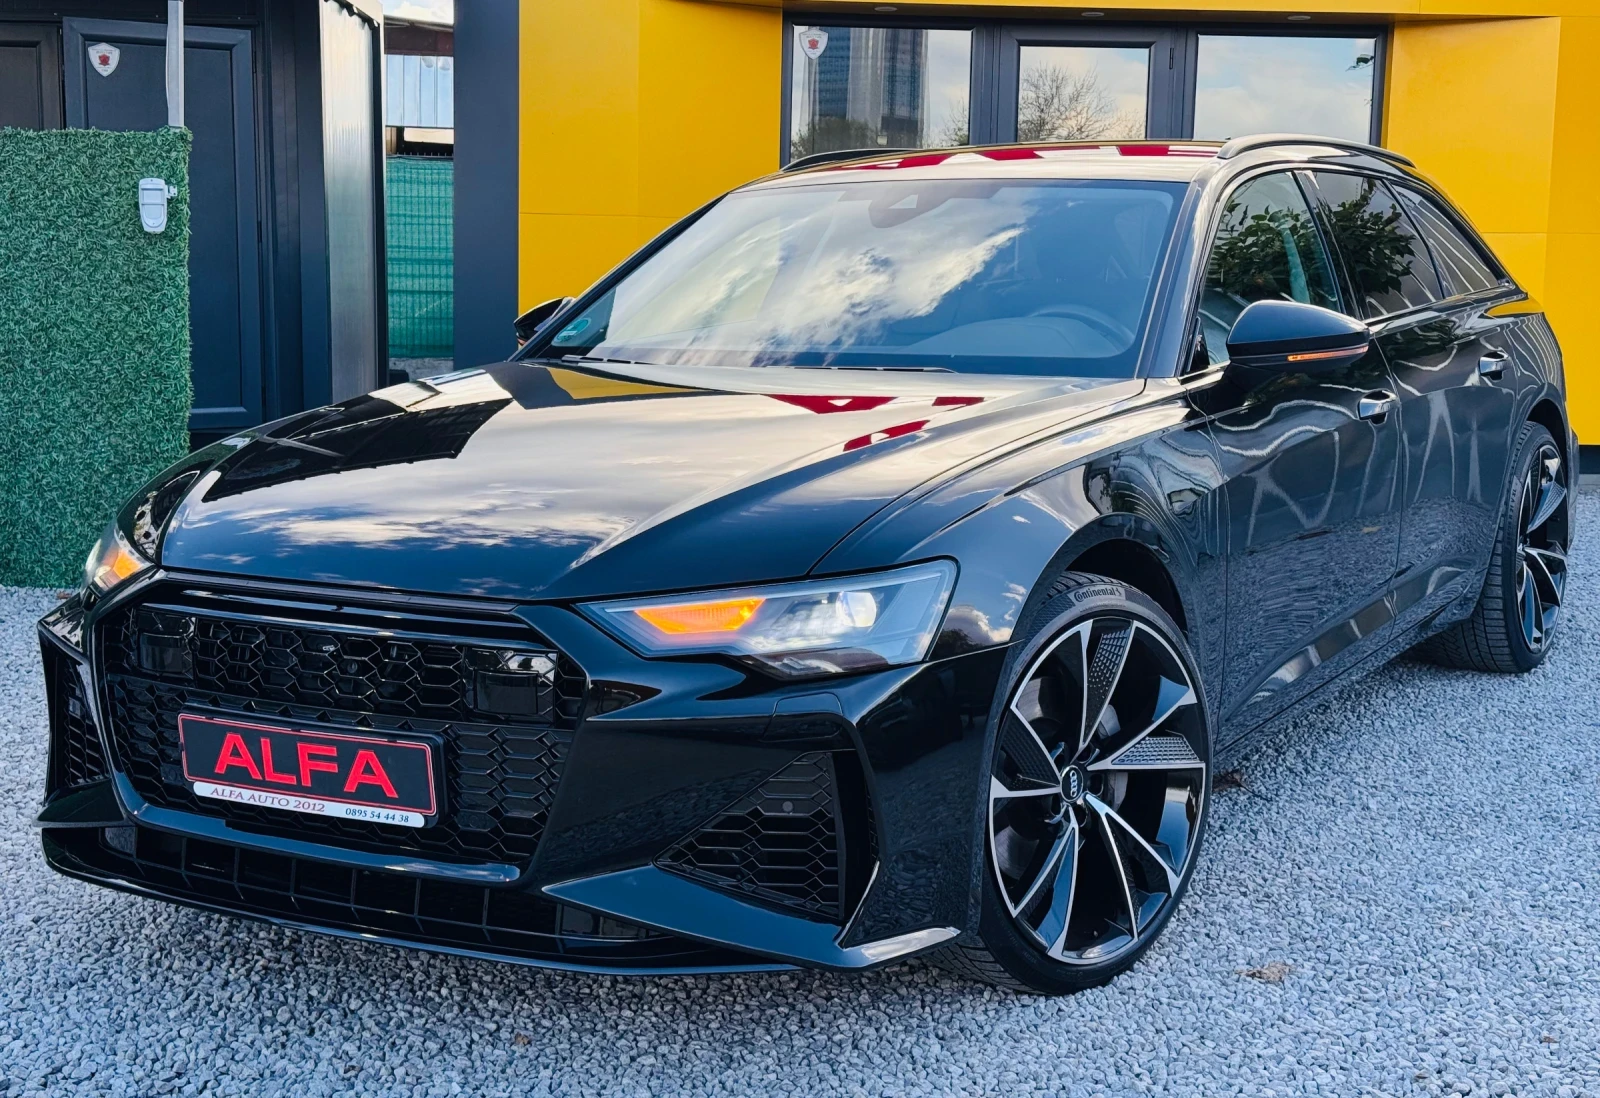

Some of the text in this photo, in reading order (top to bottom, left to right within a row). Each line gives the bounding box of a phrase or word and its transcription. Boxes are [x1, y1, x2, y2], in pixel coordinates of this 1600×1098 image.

[1074, 587, 1116, 602] Continental
[214, 732, 399, 799] ALFA
[210, 787, 409, 823] ALFA AUTO 2012 0895 54 44 38
